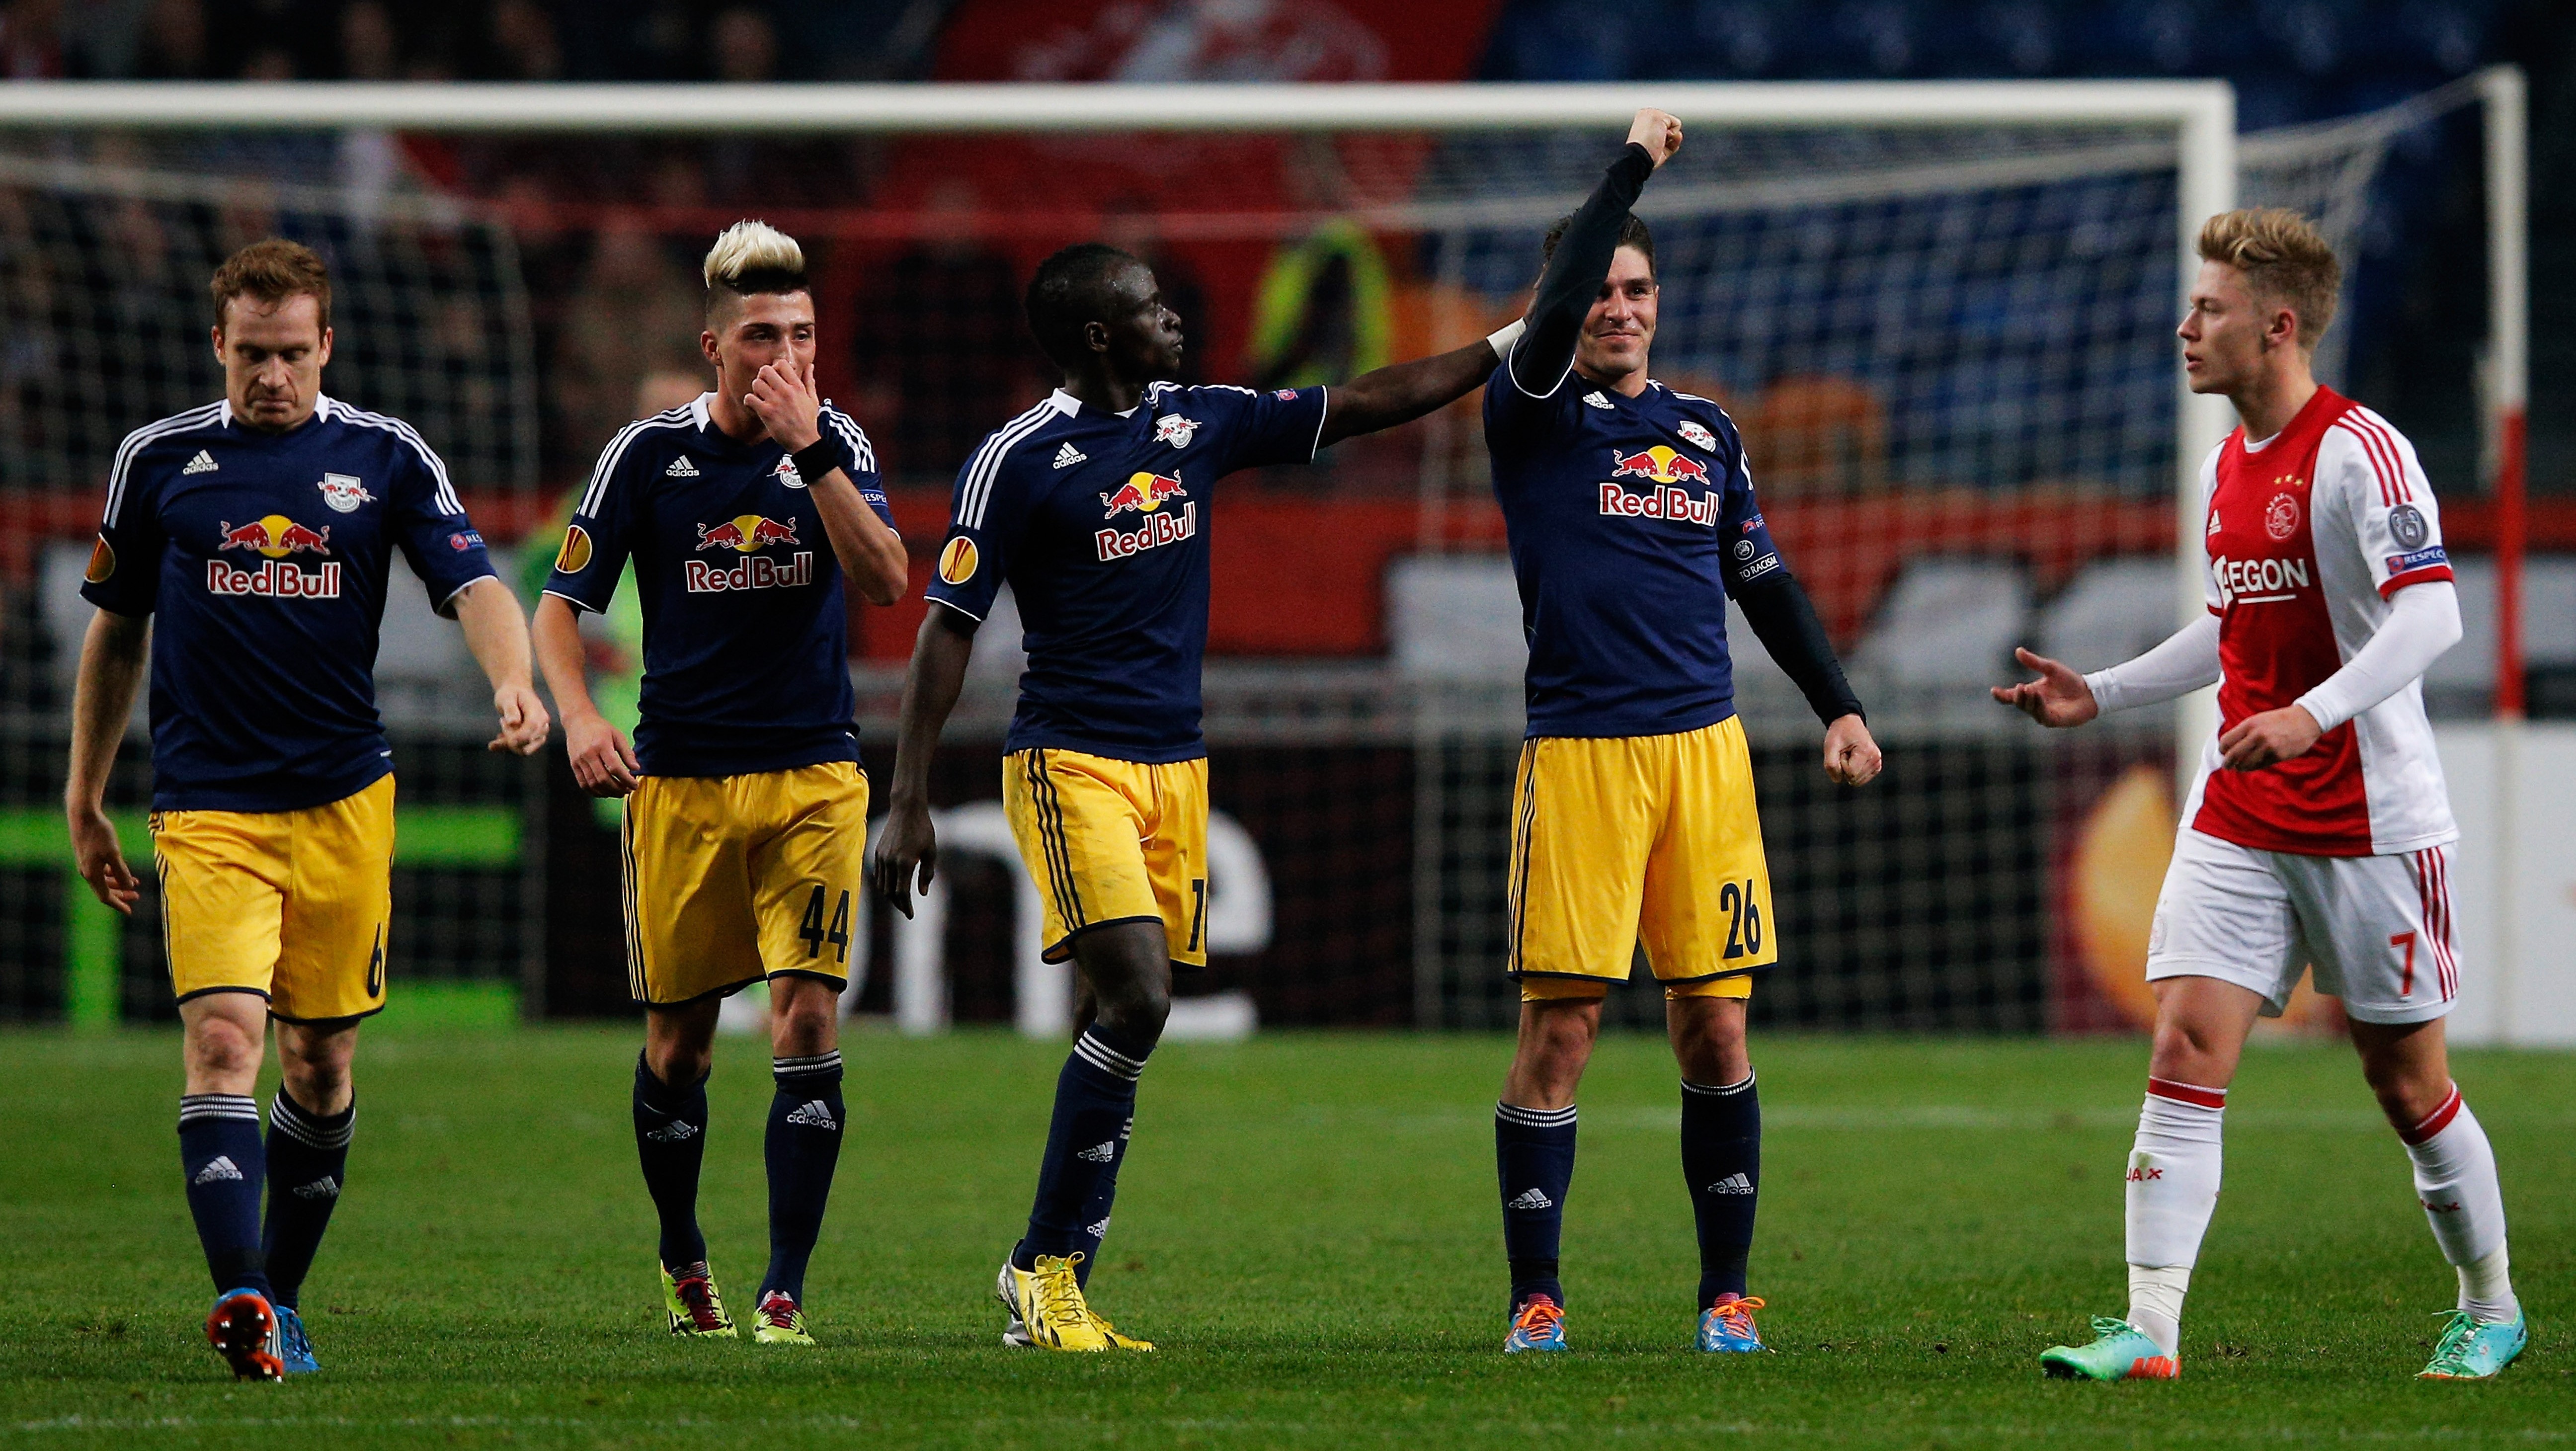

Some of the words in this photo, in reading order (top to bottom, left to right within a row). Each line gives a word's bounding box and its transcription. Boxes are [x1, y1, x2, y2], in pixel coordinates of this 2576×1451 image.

[1583, 396, 1614, 409] adidas
[182, 462, 219, 476] adidas
[1053, 453, 1087, 469] adidas
[1600, 483, 1665, 519] Red
[1667, 487, 1719, 527] Bull
[1095, 514, 1155, 562] Red
[1154, 501, 1196, 546] Bull
[208, 559, 273, 596] Red
[276, 562, 340, 599] Bull
[685, 556, 750, 592] Red
[752, 552, 812, 588] Bull
[1739, 569, 1750, 579] TO
[1750, 556, 1778, 574] RACISM
[799, 885, 850, 963] 44
[1188, 879, 1208, 954] 1
[1720, 879, 1761, 959] 26
[367, 922, 382, 998] 6
[2390, 930, 2416, 997] 7
[787, 1113, 836, 1130] adidas
[1509, 1200, 1552, 1209] adidas
